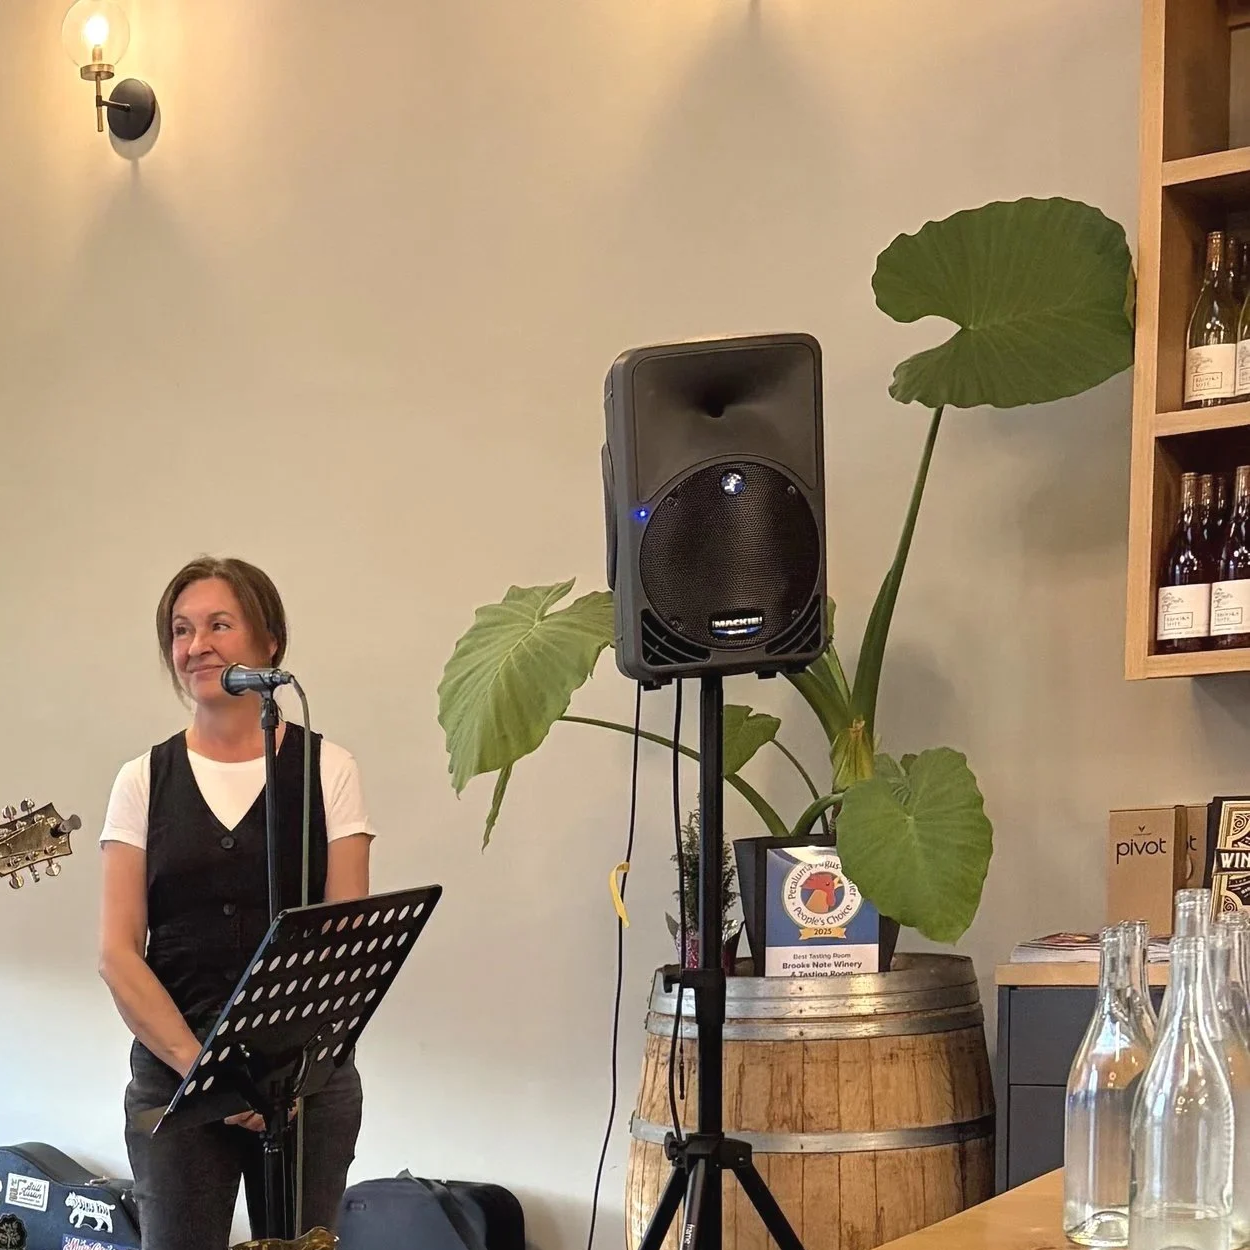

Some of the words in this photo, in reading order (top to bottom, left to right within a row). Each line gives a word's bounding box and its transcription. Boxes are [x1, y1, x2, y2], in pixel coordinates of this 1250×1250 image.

[714, 617, 759, 628] MACKIE
[1116, 838, 1166, 865] pivot
[788, 863, 813, 900] Petaluma
[793, 906, 825, 926] People's
[826, 904, 853, 926] Choice
[782, 962, 810, 970] Brooks
[812, 961, 832, 969] Note
[833, 960, 863, 970] Winery
